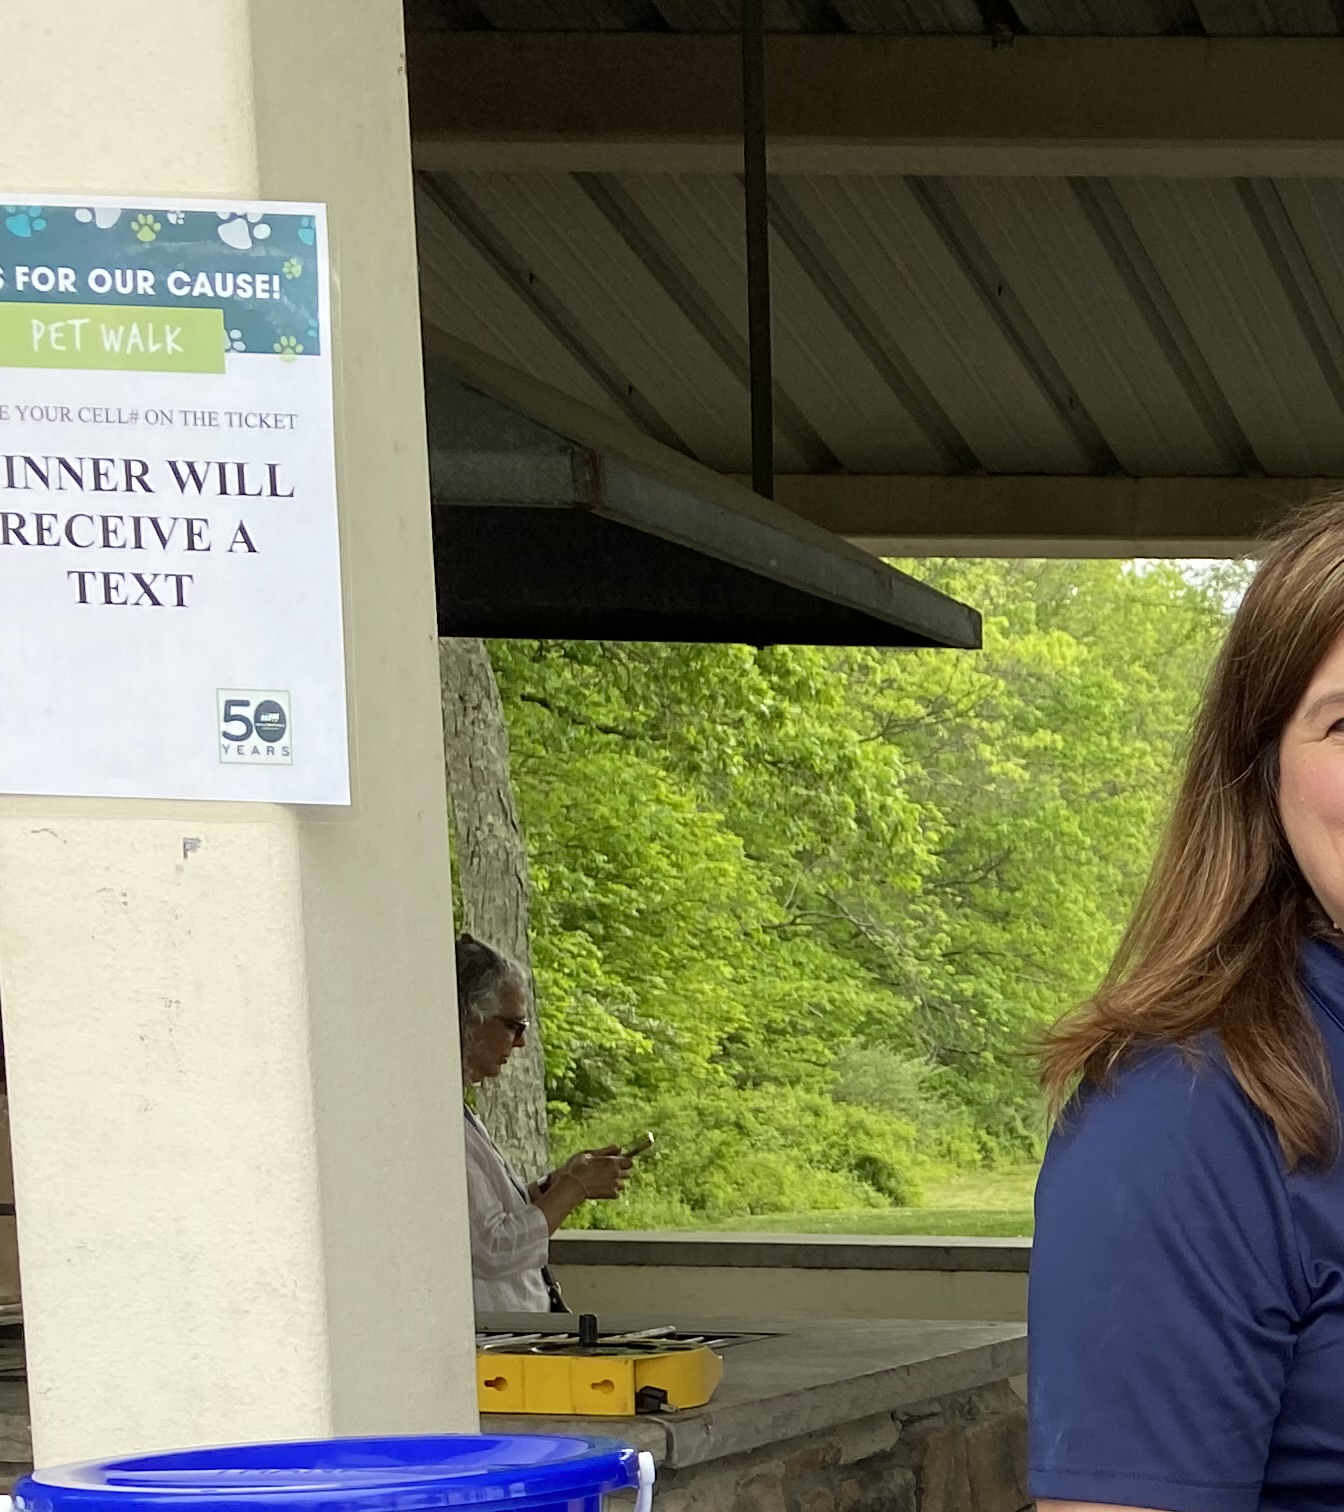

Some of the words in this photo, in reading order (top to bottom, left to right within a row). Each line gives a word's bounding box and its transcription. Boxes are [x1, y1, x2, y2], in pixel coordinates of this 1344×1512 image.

[15, 265, 78, 294] FOR
[88, 268, 156, 296] OUR
[167, 271, 281, 300] CAUSE!
[30, 317, 91, 353] PET
[100, 322, 184, 355] WALK
[15, 404, 74, 424] YOUR
[77, 406, 140, 426] CELL#
[145, 408, 175, 427] ON
[179, 409, 220, 429] THE
[224, 411, 299, 431] TICKET
[0, 453, 156, 495] INNER
[164, 459, 296, 499] WILL
[0, 511, 213, 553] RECEIVE
[227, 519, 261, 555] A
[66, 569, 196, 609] TEXT
[222, 699, 287, 744] 50
[222, 743, 291, 757] YEARS
